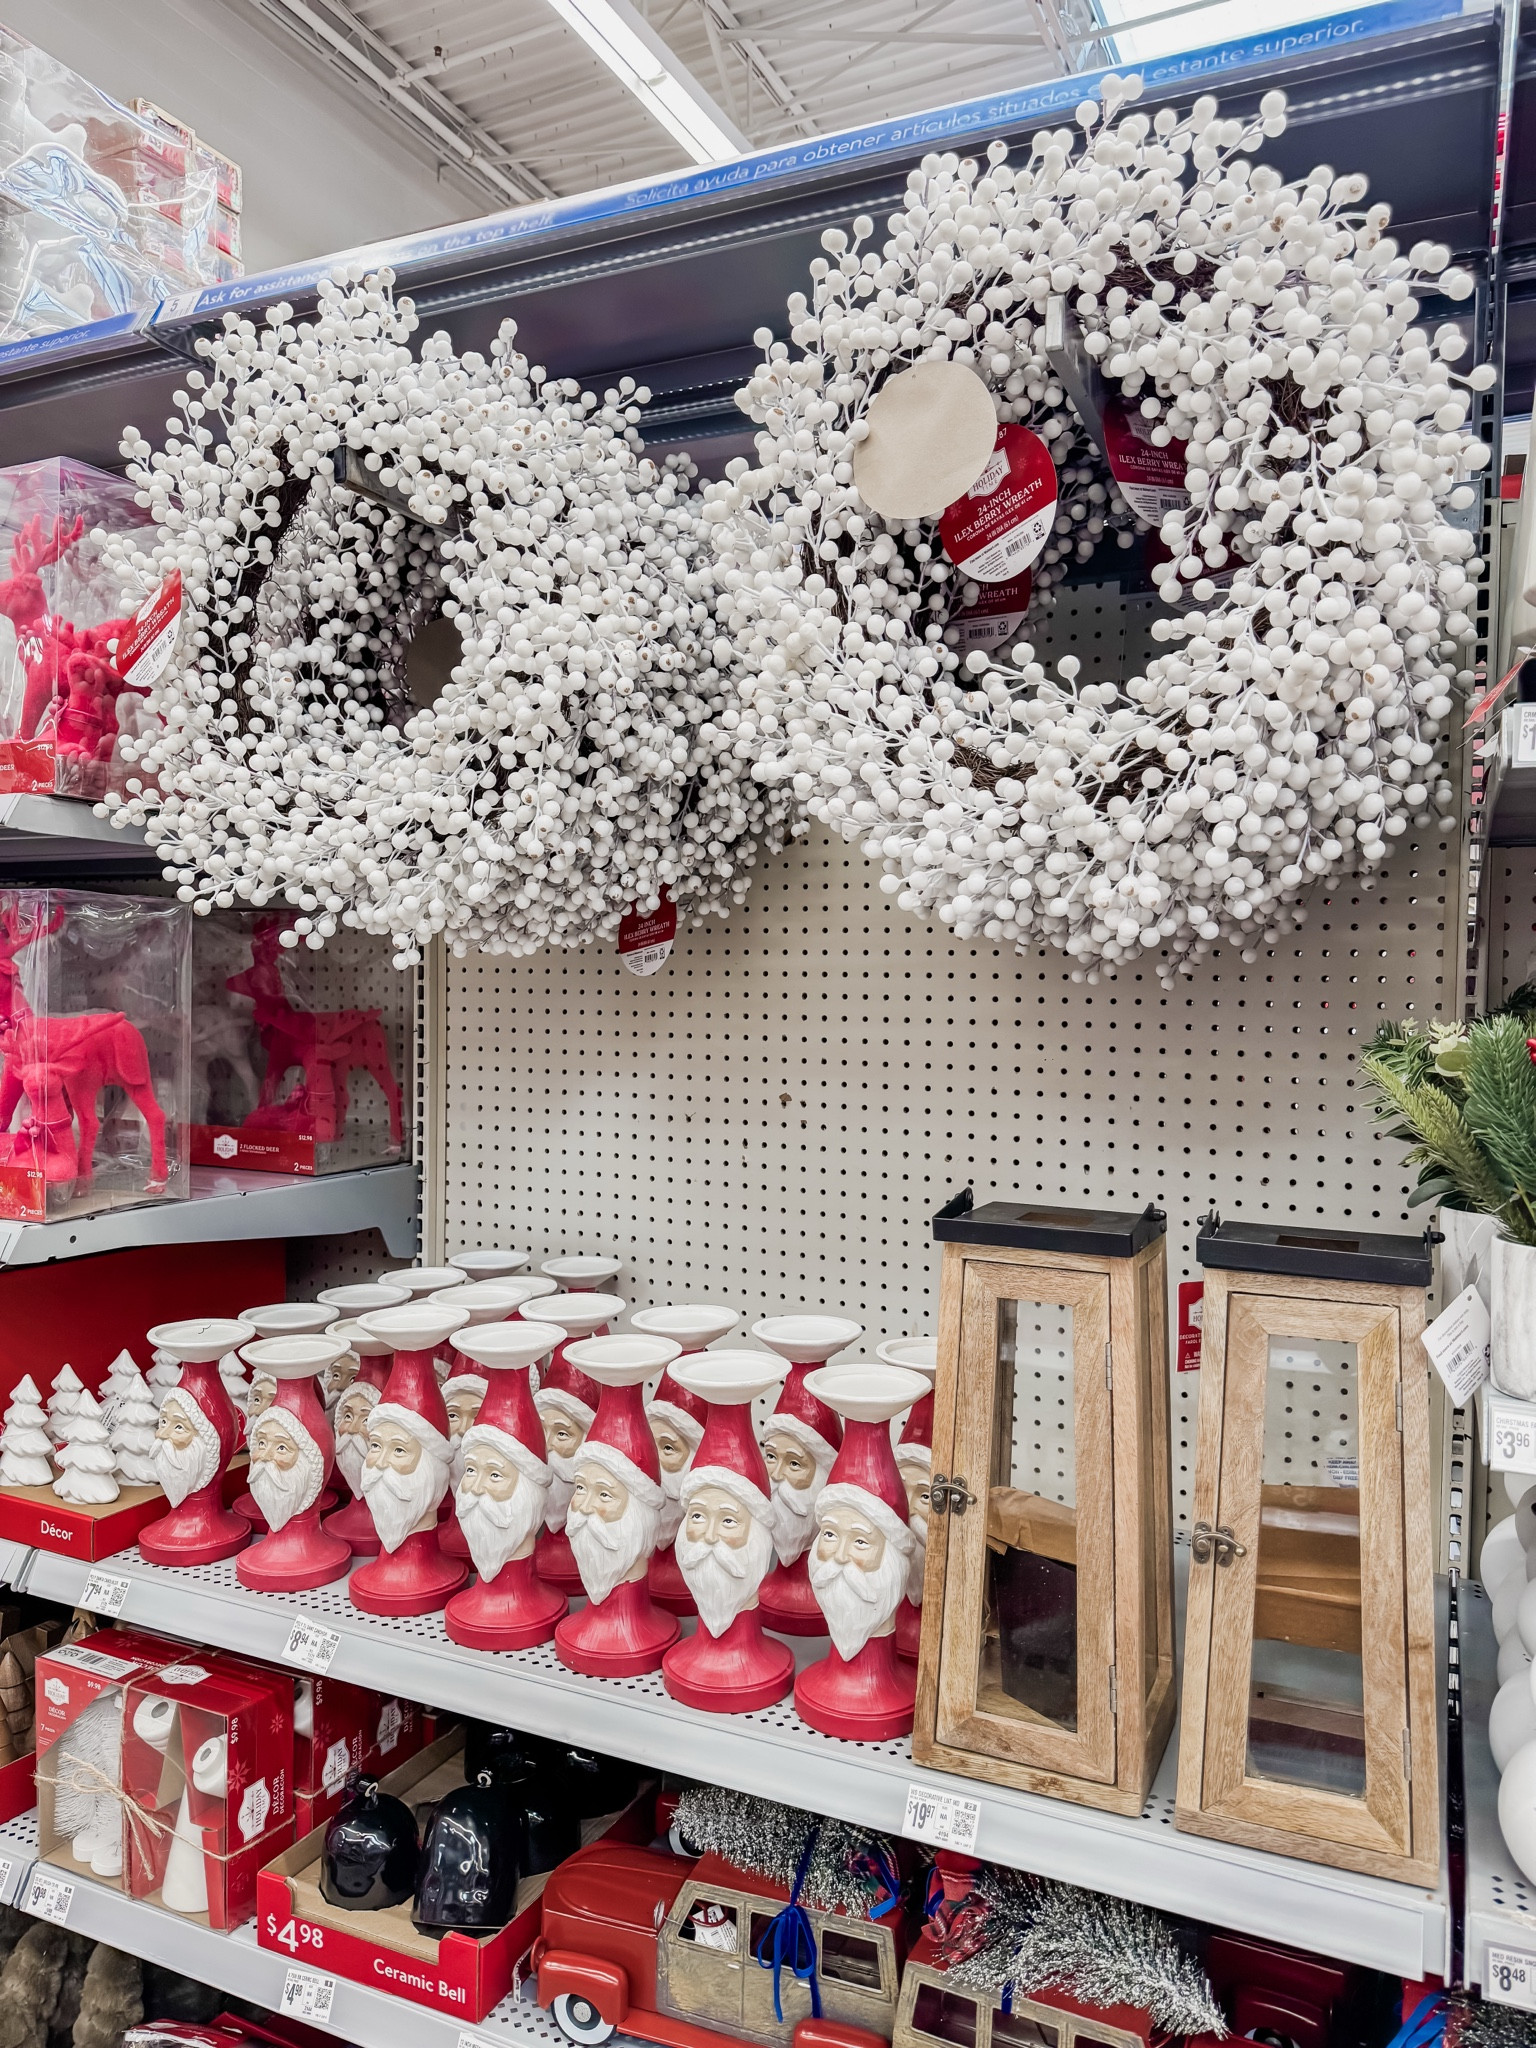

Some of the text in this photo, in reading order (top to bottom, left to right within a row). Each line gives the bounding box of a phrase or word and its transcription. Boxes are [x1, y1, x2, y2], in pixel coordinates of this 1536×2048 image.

[625, 183, 689, 206] Solicita
[694, 166, 749, 195] ayuda
[753, 155, 797, 181] para
[803, 132, 887, 162] obtener
[890, 111, 982, 142] artículos
[987, 84, 1081, 116] situados
[1152, 45, 1246, 82] estante
[1252, 18, 1365, 58] superior.
[444, 233, 471, 250] the
[476, 226, 505, 244] top
[199, 268, 333, 308] Ask for assistance
[170, 300, 178, 313] 5
[1118, 454, 1187, 470] ILEX BERRY WREAT
[1140, 448, 1169, 460] 24-INCH
[972, 465, 1004, 492] HOLIDAY
[953, 524, 974, 543] ILEX
[973, 504, 1002, 530] BERRY
[1002, 477, 1043, 510] WREATH
[977, 487, 1012, 517] 24-INCH
[979, 587, 1018, 600] WREATH
[31, 779, 38, 791] 2
[266, 1145, 280, 1153] DEER
[293, 1162, 299, 1172] 2
[20, 1205, 27, 1217] 2
[40, 1519, 73, 1542] Décor
[315, 1679, 323, 1706] $9.98
[40, 1722, 46, 1732] 7
[230, 1717, 239, 1745] $9.98
[272, 1775, 280, 1816] DÉCOR
[918, 1790, 943, 1803] DECORATIVE
[939, 1813, 948, 1821] NA
[373, 1957, 467, 2005] Ceramic Bell
